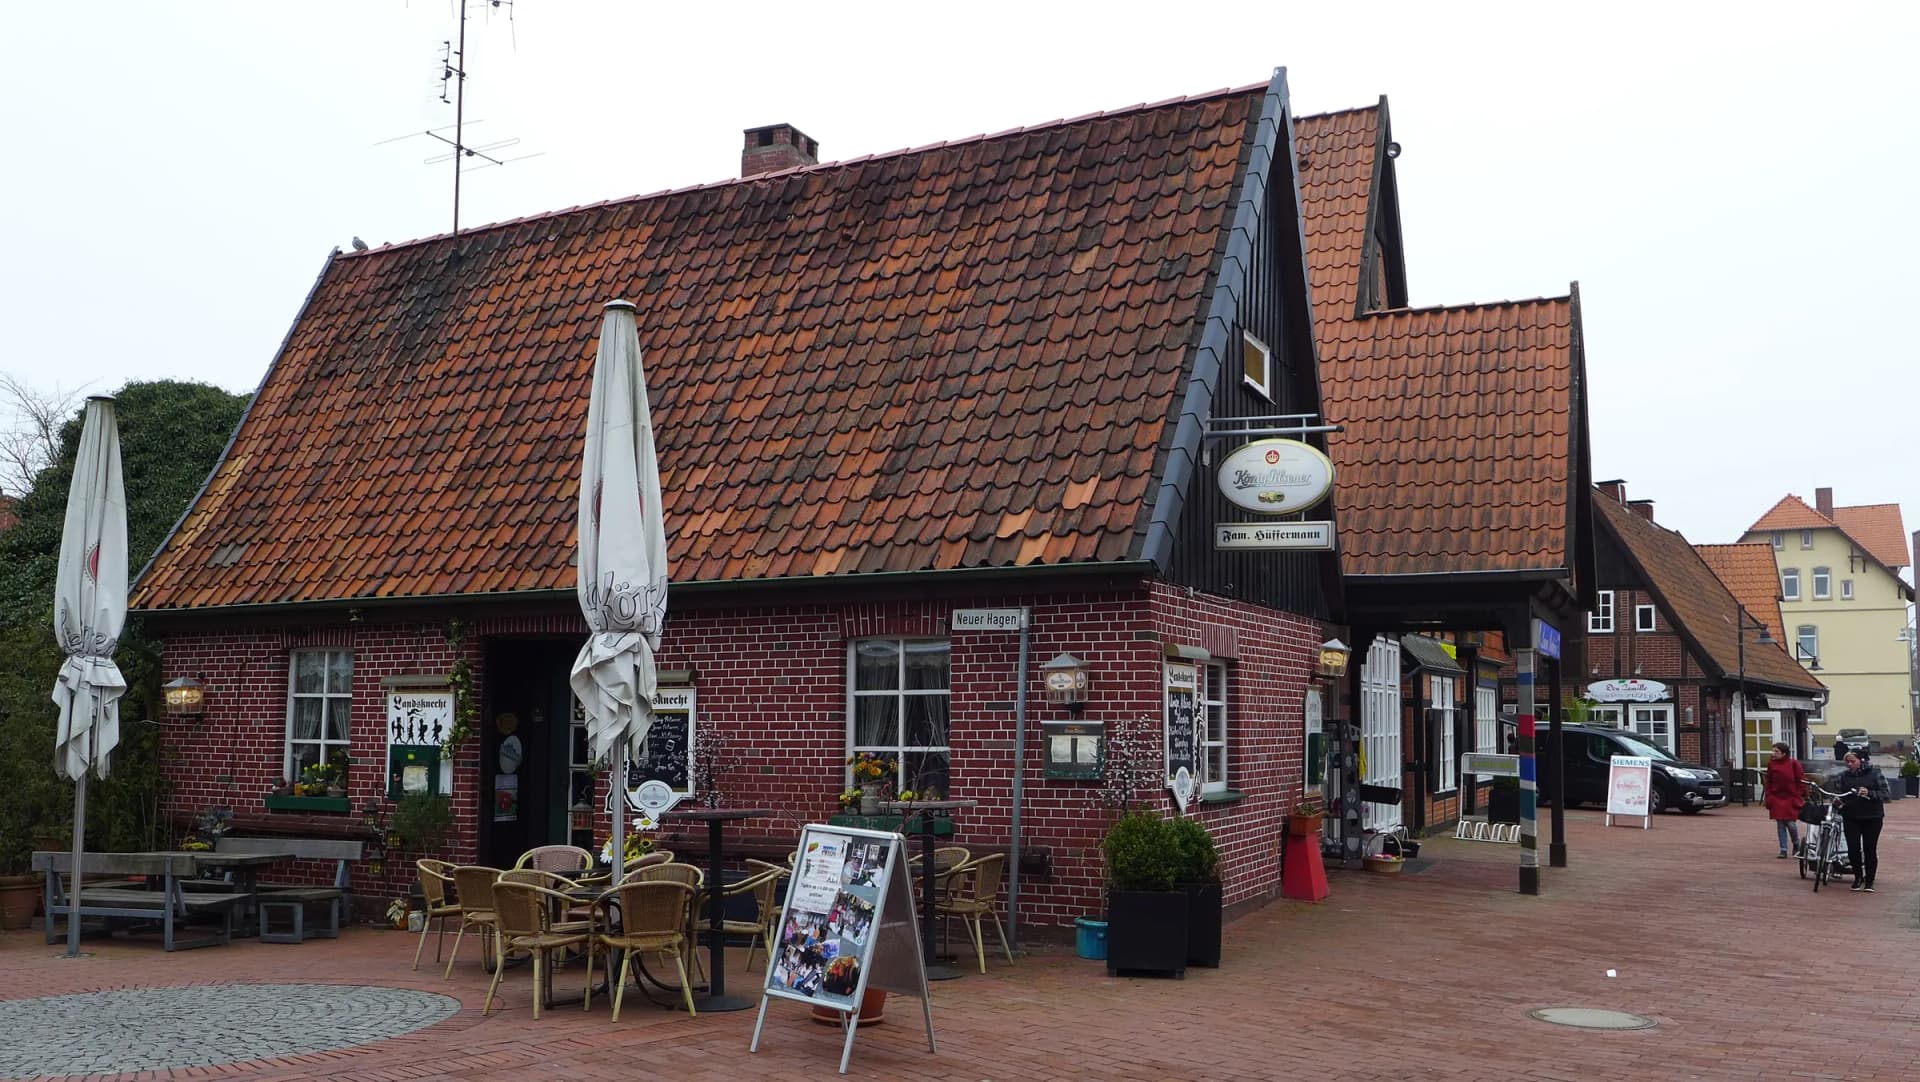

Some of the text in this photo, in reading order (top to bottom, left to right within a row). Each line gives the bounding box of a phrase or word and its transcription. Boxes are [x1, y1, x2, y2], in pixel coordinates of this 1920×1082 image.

[1222, 528, 1320, 543] Fam. Hüffermann
[957, 612, 1017, 628] Neuer Hagen
[393, 695, 447, 711] Landsknecht
[652, 694, 689, 708] sknecht
[1612, 758, 1650, 767] SIEMENS
